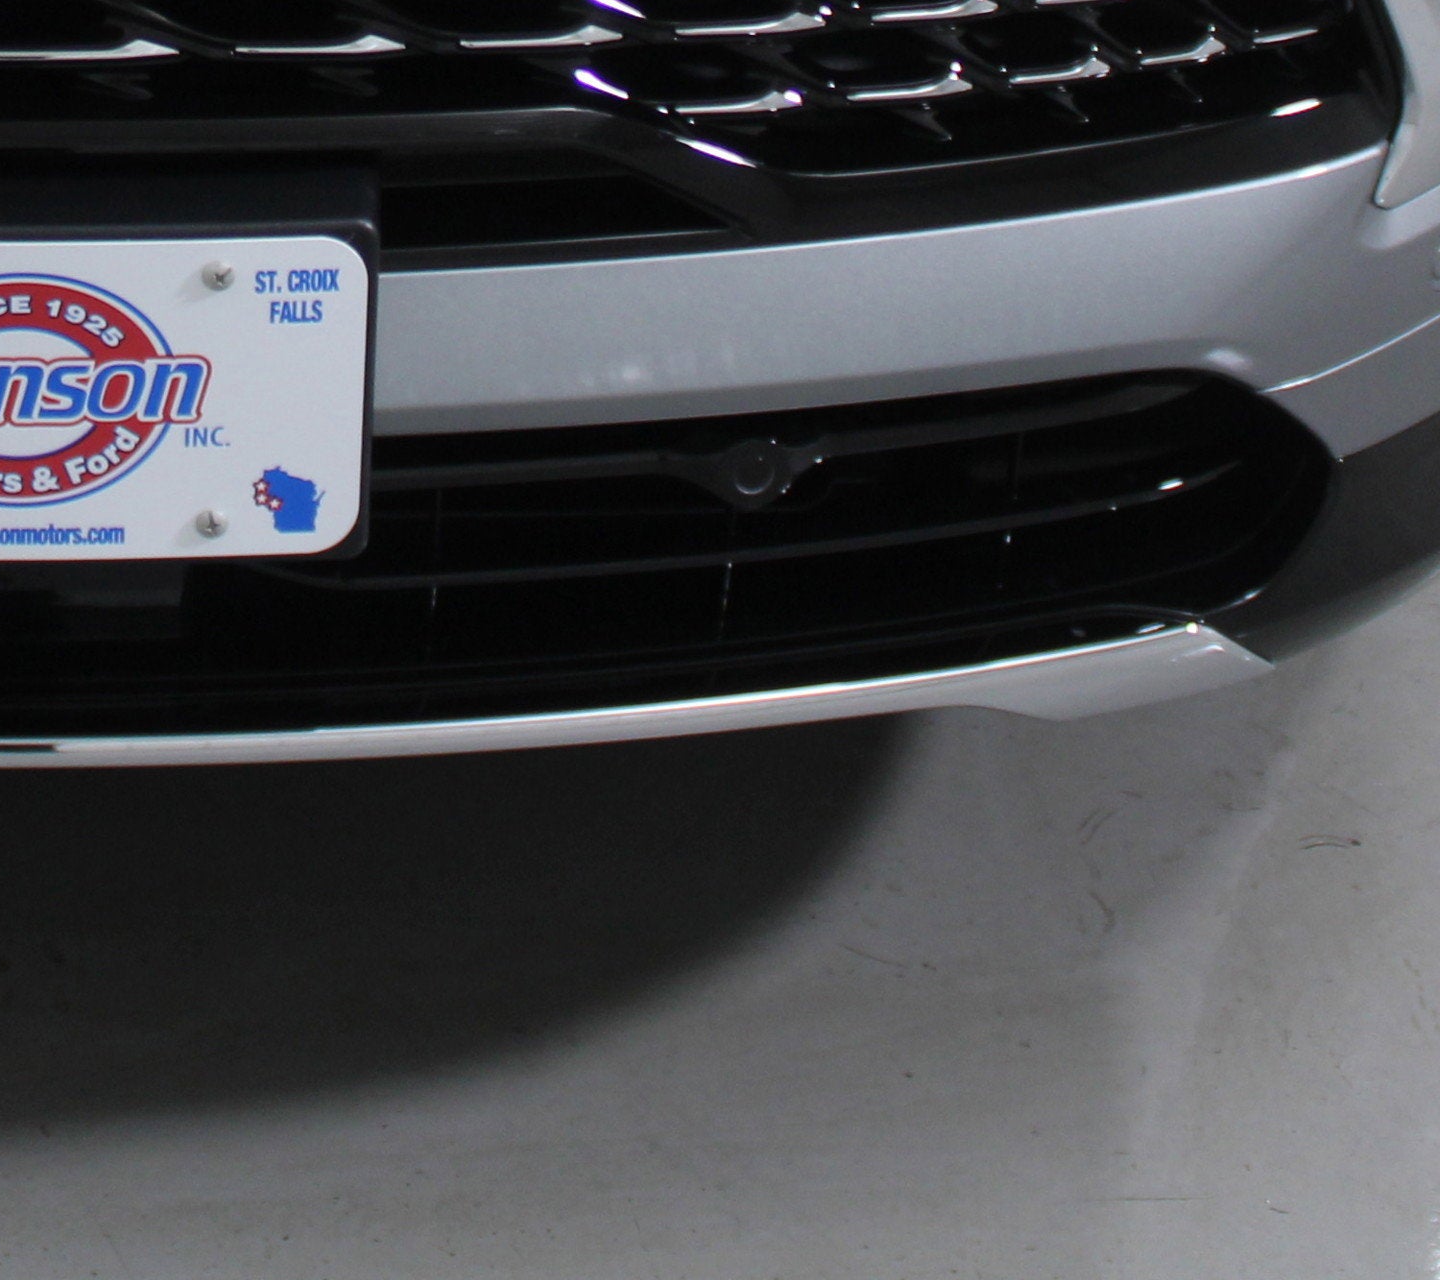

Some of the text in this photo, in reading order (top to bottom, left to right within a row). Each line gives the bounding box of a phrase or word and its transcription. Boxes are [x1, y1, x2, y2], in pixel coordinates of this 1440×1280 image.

[254, 269, 339, 293] ST. CROIX
[46, 298, 125, 348] 1925
[270, 300, 323, 323] FALLS
[184, 427, 231, 448] INC.
[31, 466, 61, 493] &
[64, 425, 140, 484] Ford
